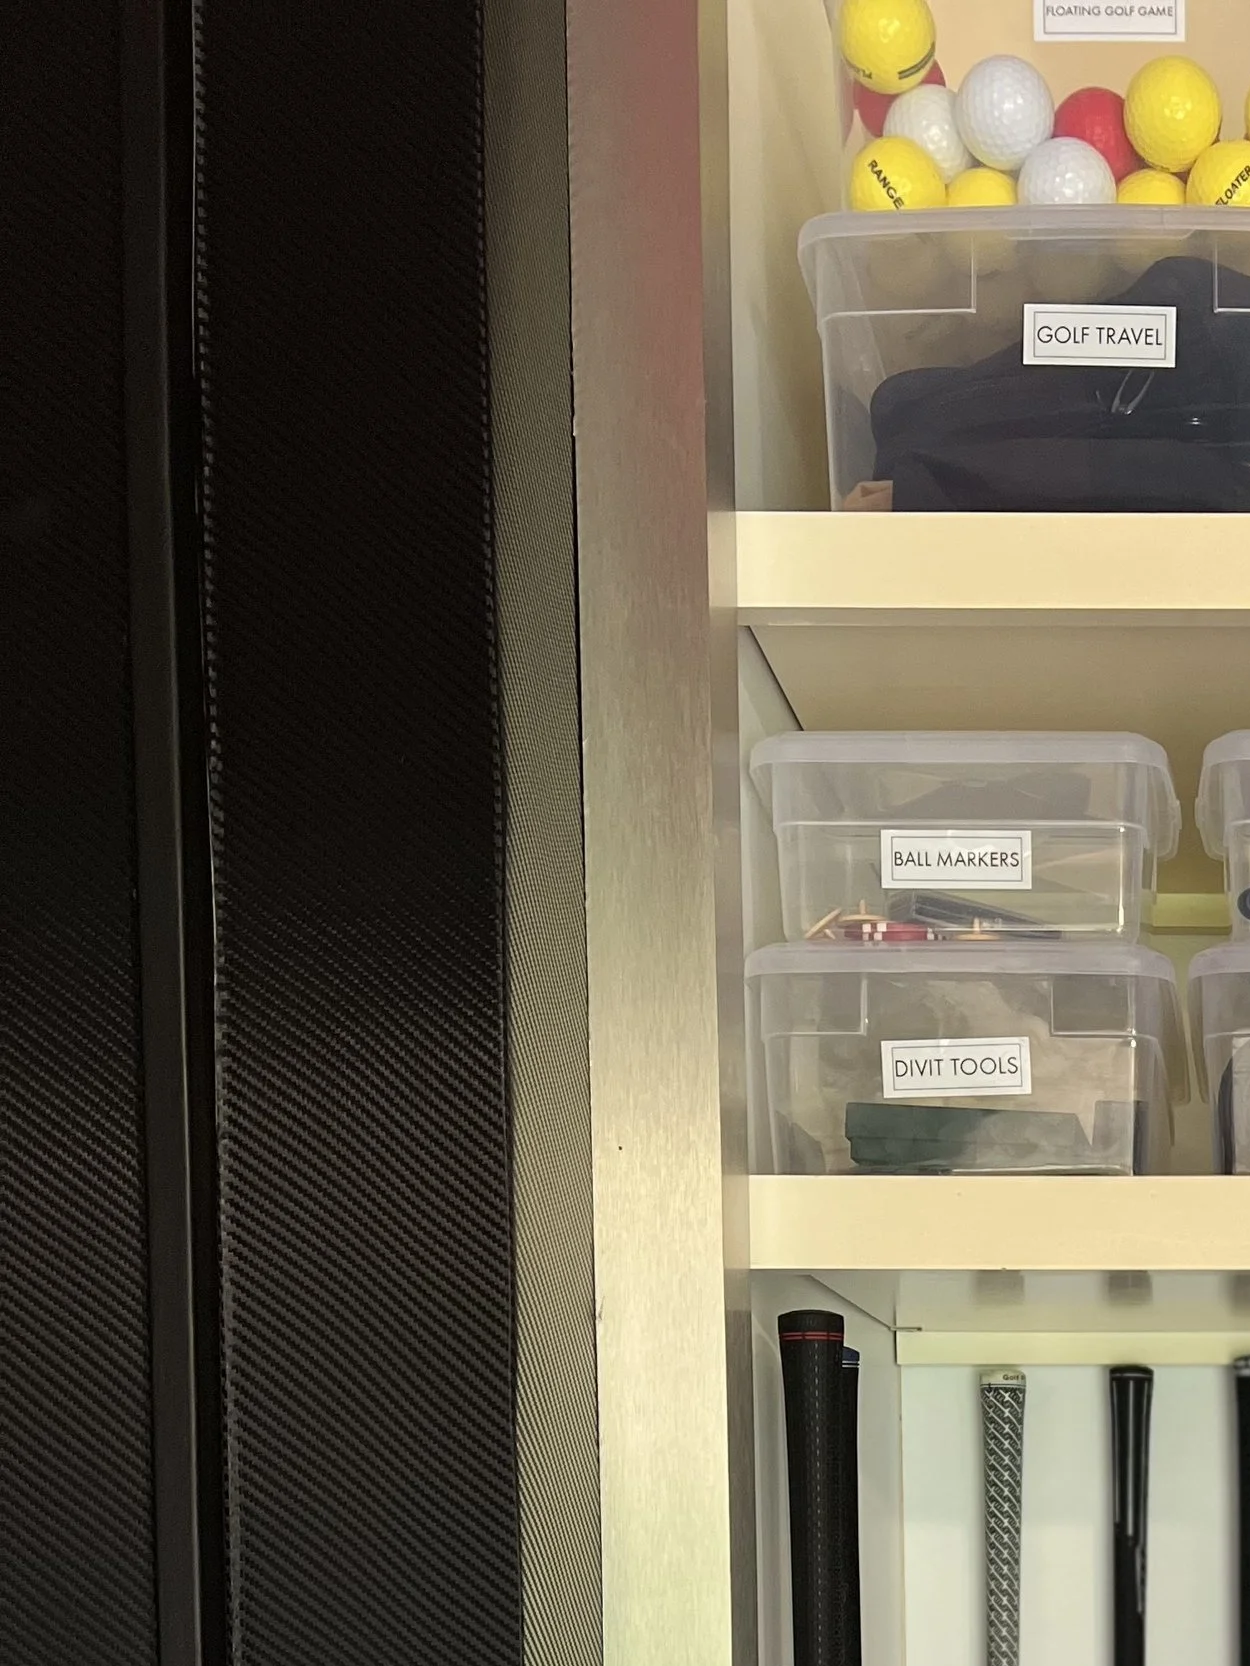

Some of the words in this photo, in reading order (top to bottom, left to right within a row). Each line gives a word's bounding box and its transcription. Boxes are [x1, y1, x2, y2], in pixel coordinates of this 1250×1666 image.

[1045, 5, 1101, 17] FLOATING
[1104, 5, 1135, 17] GOLF
[1138, 5, 1174, 17] GAME
[867, 159, 905, 211] RANGE
[1036, 325, 1090, 344] GOLF
[1095, 326, 1163, 346] TRAVEL
[893, 850, 932, 867] BALL
[936, 851, 1020, 868] MARKERS
[894, 1058, 944, 1078] DIVIT
[949, 1056, 1019, 1077] TOOLS
